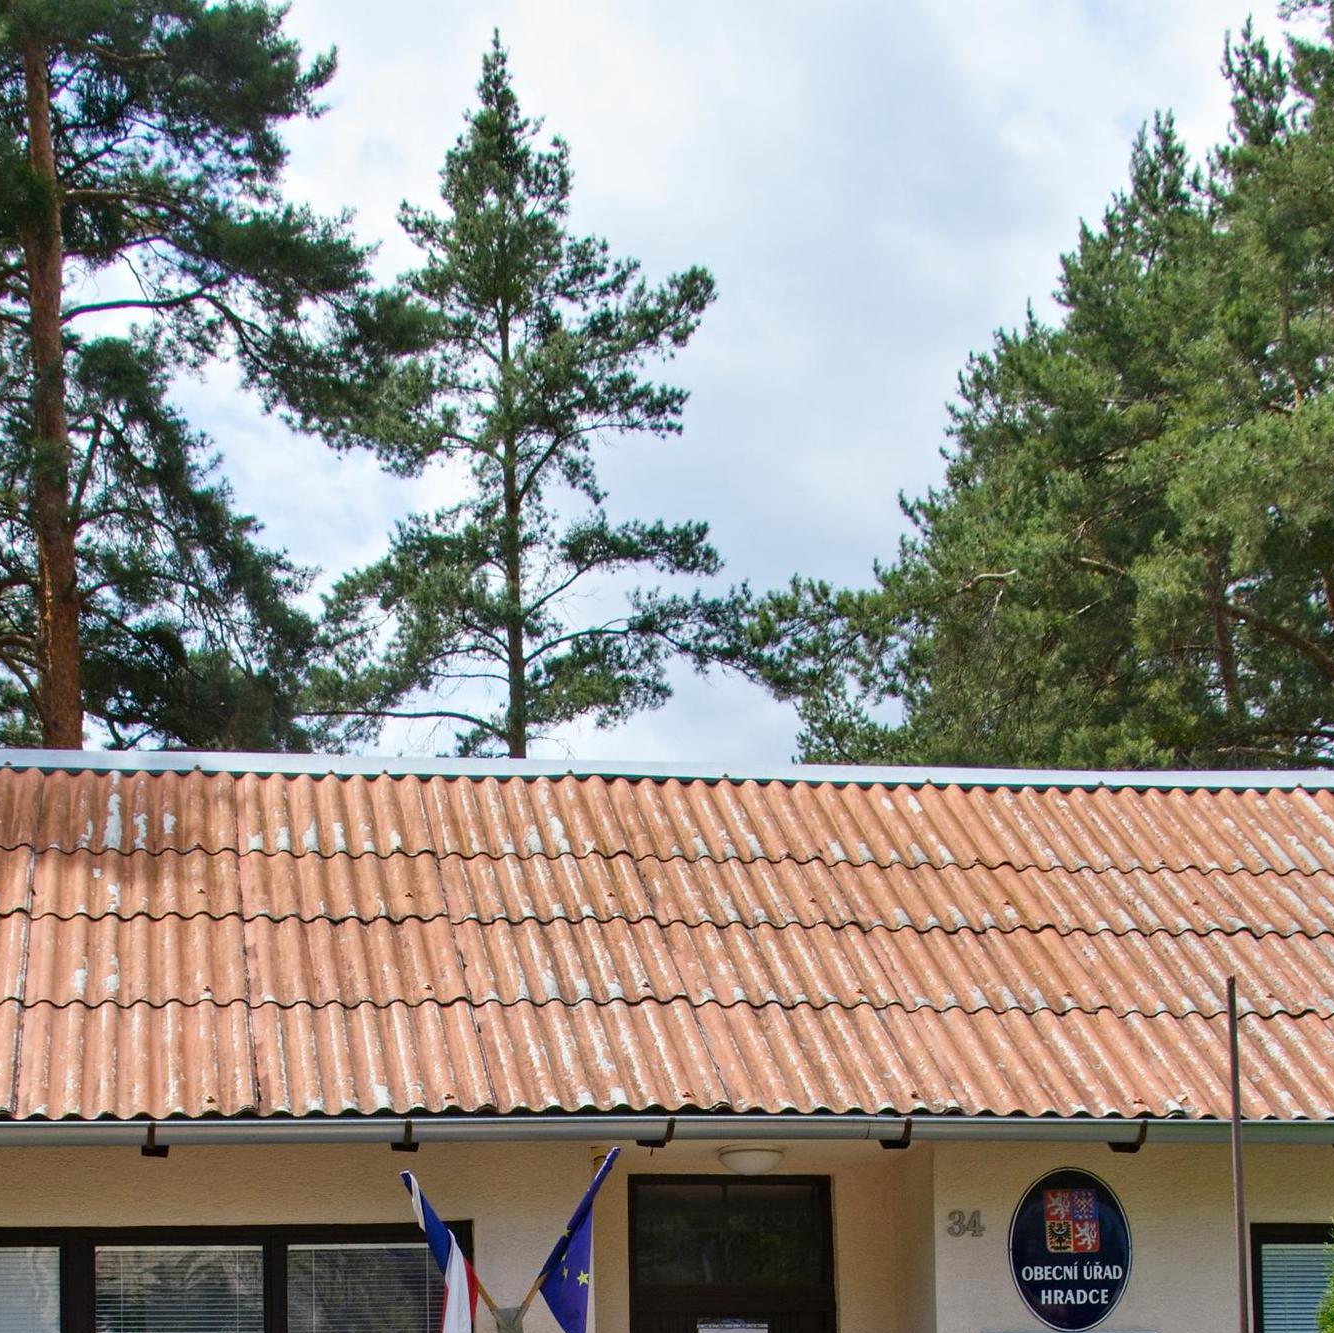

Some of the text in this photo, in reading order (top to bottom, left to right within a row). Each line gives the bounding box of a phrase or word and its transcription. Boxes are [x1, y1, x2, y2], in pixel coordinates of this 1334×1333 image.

[947, 1209, 986, 1238] 34
[1021, 1261, 1123, 1281] OBECNÍ ÚŘAD
[1041, 1289, 1109, 1304] HRADCE
